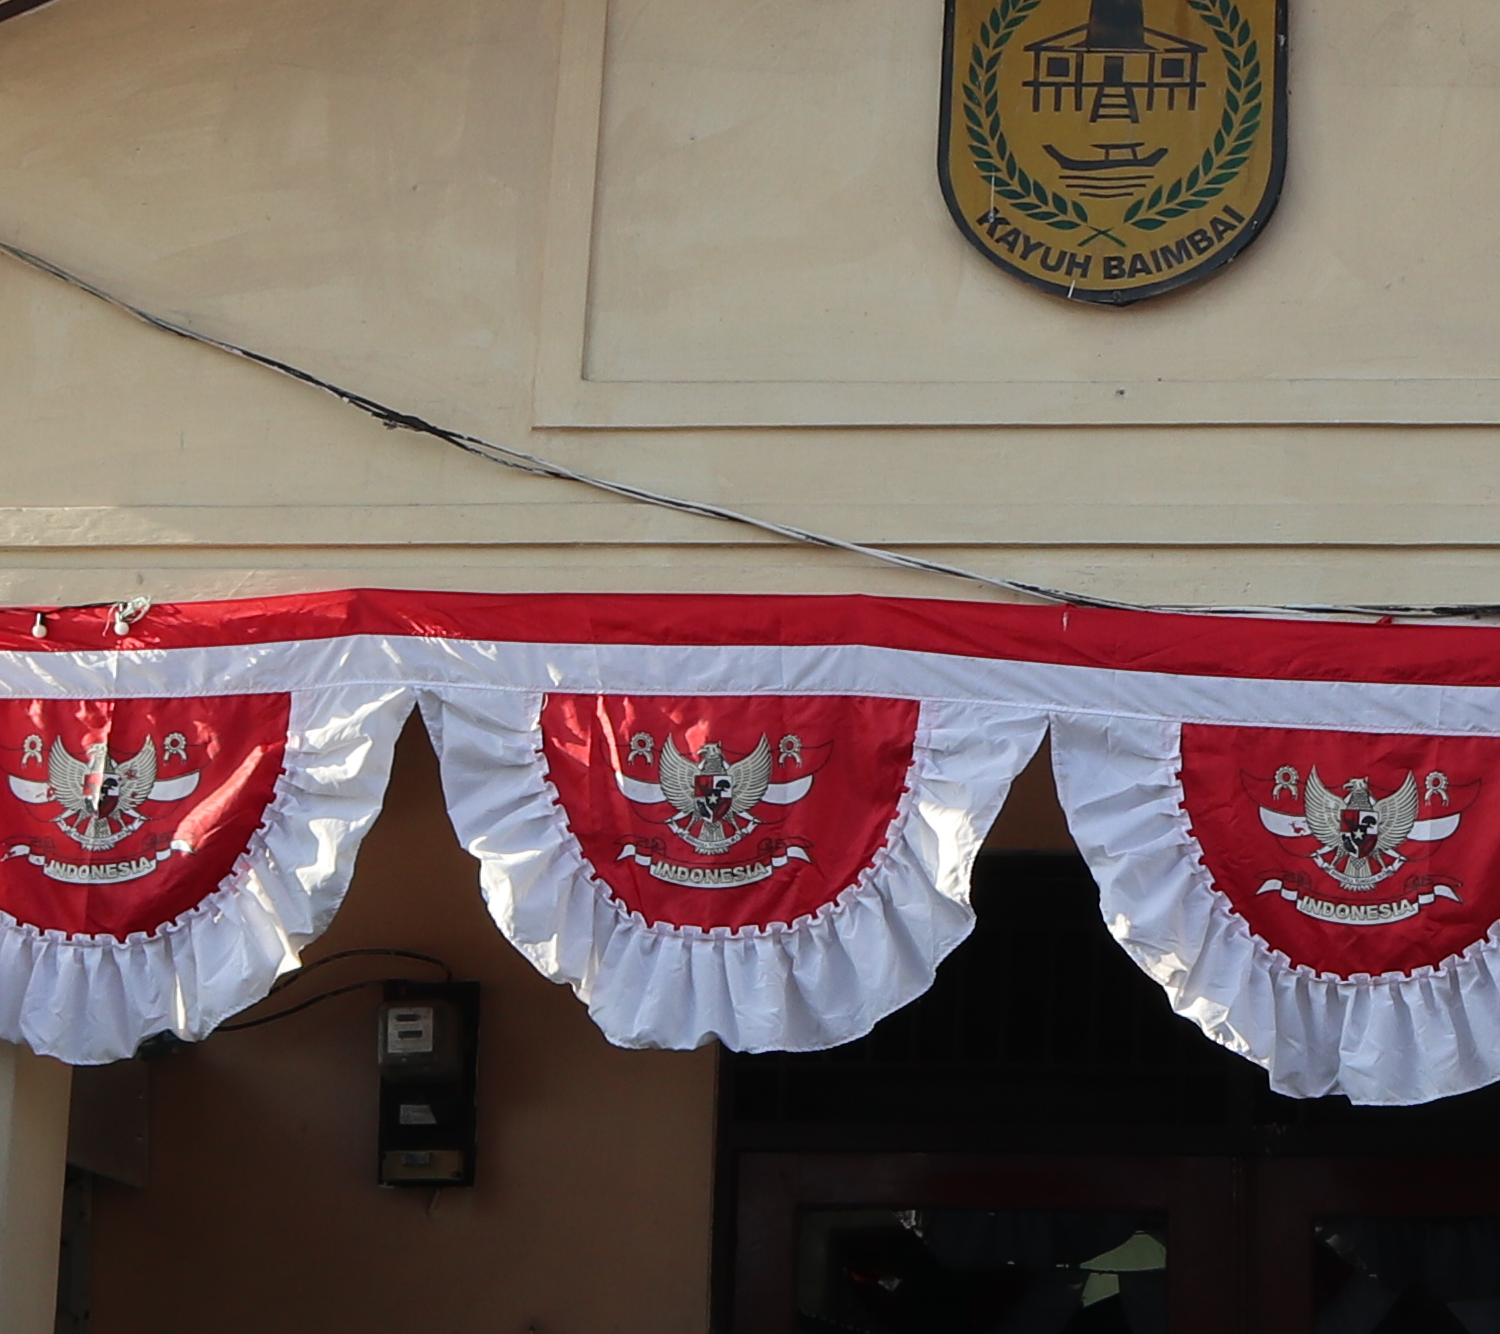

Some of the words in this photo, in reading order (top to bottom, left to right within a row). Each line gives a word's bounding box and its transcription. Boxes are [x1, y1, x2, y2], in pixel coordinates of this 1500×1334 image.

[976, 207, 1093, 278] KAYUH
[1102, 205, 1245, 280] BAIMBAI
[50, 857, 152, 880] INDONESIA
[655, 860, 768, 884] INDONESIA
[1301, 895, 1415, 920] INDONESIA
